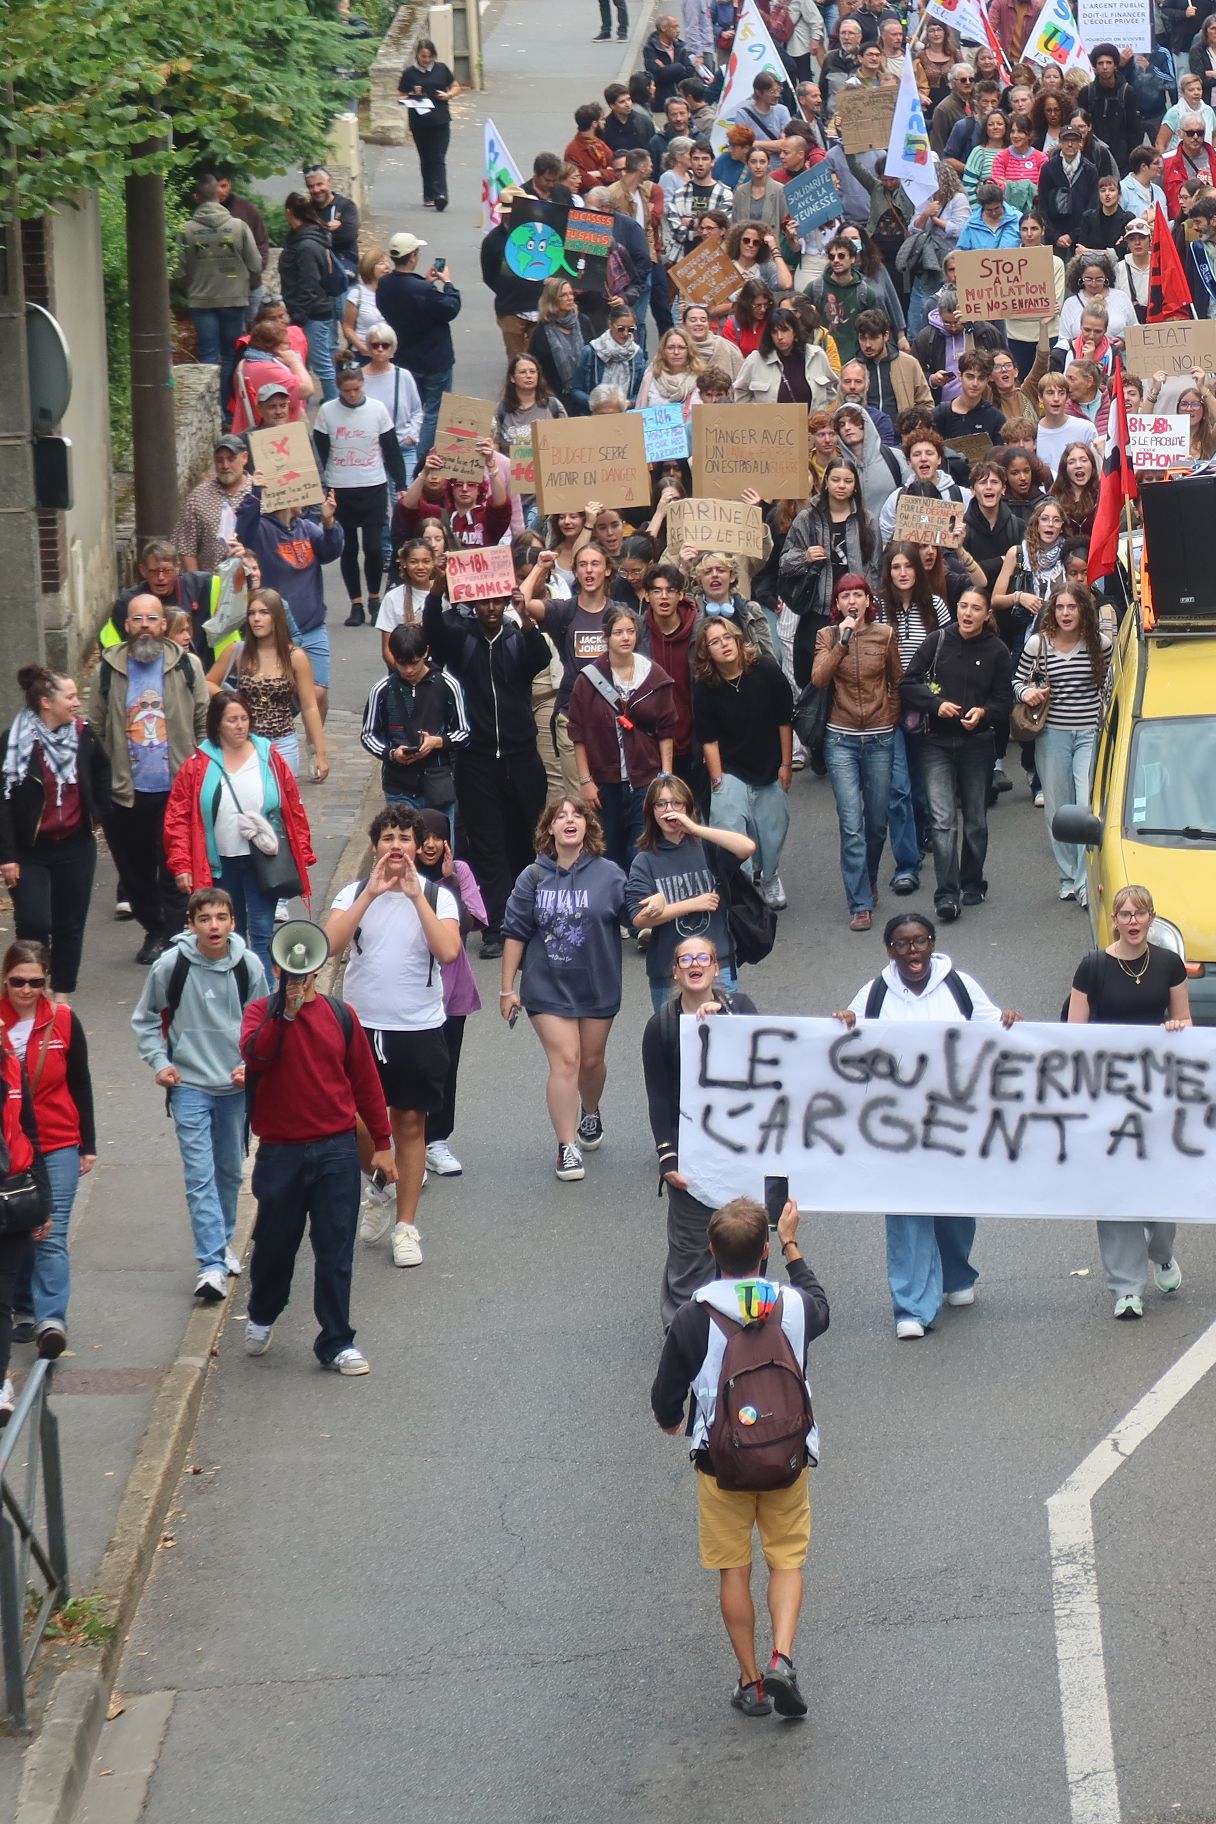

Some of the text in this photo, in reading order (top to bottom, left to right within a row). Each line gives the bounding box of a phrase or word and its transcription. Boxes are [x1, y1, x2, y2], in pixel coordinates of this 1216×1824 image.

[793, 192, 838, 224] JEUNESSE
[797, 187, 828, 210] AVEC LA
[567, 229, 576, 239] TU
[979, 258, 1028, 278] STOP
[965, 281, 1047, 302] MUTILATION
[965, 298, 1050, 314] DE NOS ENFANTS
[1171, 354, 1213, 372] NOUS
[705, 428, 795, 446] MANGER AVEC
[551, 446, 594, 465] BUDGET
[705, 445, 724, 460] UN
[583, 471, 597, 486] EN
[600, 465, 638, 482] DANGER
[670, 501, 742, 525] MARINE
[670, 526, 762, 551] REND LE FRIC
[447, 552, 489, 577] 8h-18h
[453, 580, 512, 601] FEMMES
[578, 644, 608, 653] JONES
[535, 888, 590, 915] NIRVANA
[697, 1023, 798, 1091] LE
[701, 1090, 1090, 1164] L'ARGENT
